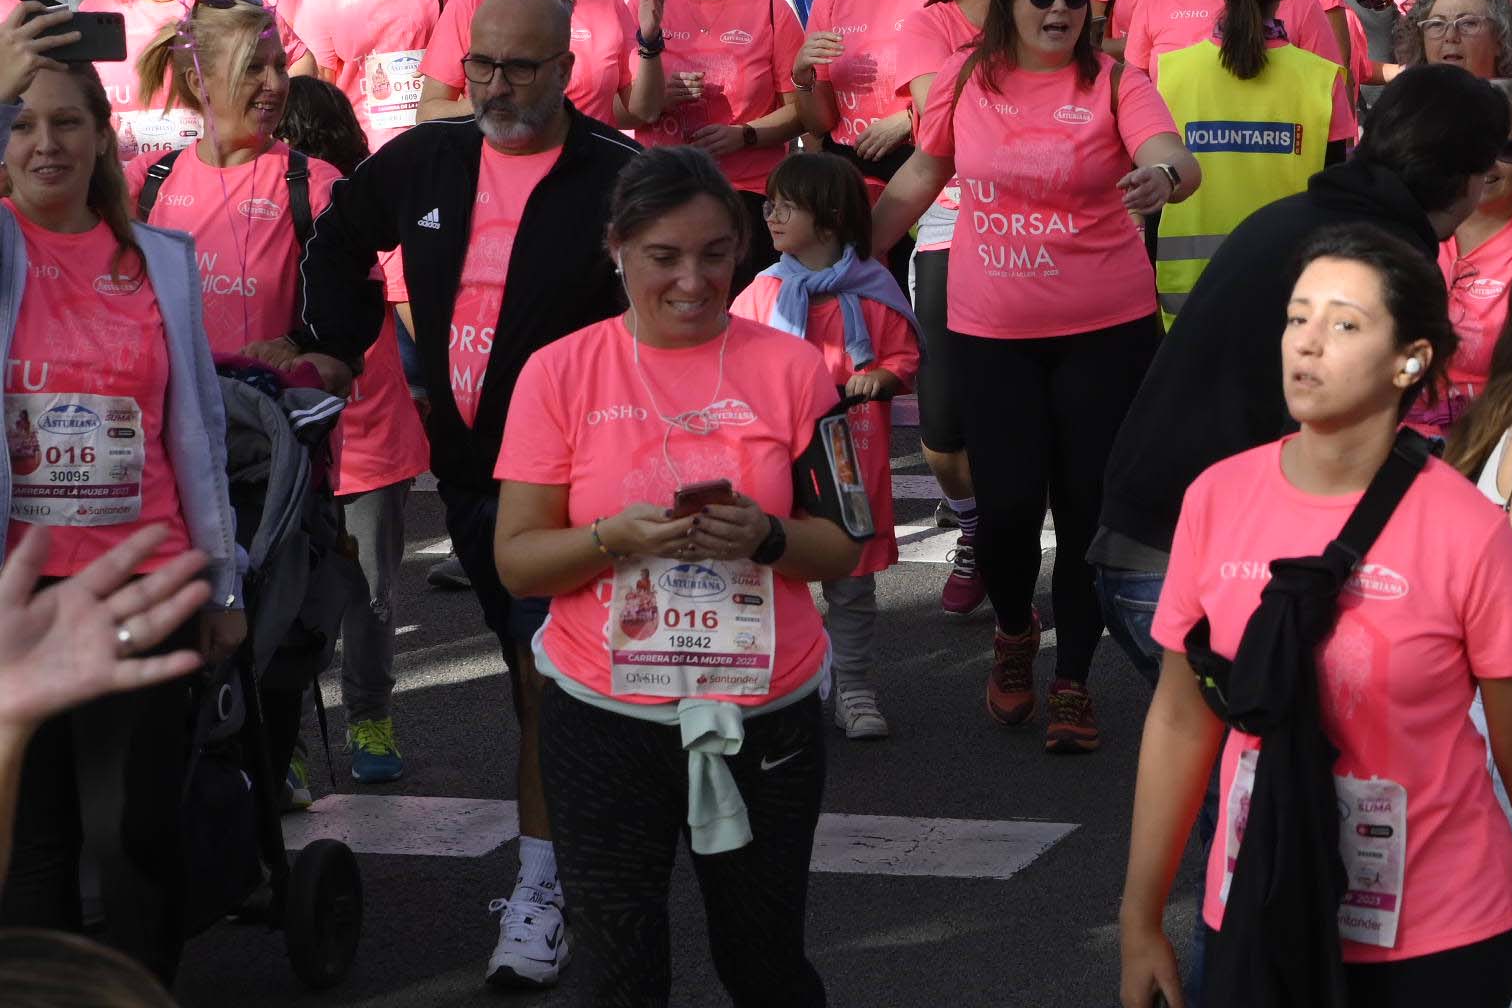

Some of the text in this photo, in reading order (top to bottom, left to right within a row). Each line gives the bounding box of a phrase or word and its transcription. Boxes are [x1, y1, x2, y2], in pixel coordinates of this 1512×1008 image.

[393, 79, 422, 91] 016
[104, 86, 130, 104] TU
[1187, 129, 1291, 146] VOLUNTARIS
[966, 178, 996, 203] TU
[160, 192, 195, 207] YSHO
[973, 211, 1080, 236] DORSAL
[977, 244, 1056, 270] SUMA
[43, 416, 97, 428] ASTURIANA
[586, 405, 648, 426] OYSHO
[45, 446, 96, 465] 016
[49, 470, 90, 482] 30095
[68, 488, 79, 496] LA
[80, 488, 109, 496] MUJER
[663, 575, 721, 591] ASTURIANA
[731, 576, 761, 587] SUMA
[663, 608, 719, 629] 016
[669, 635, 712, 649] 19842
[628, 654, 671, 663] CARRERA
[672, 655, 684, 663] DE
[686, 655, 699, 663] LA
[701, 656, 733, 665] MUJER
[625, 672, 759, 684] OYSHO Santander
[1338, 915, 1383, 930] ntander
